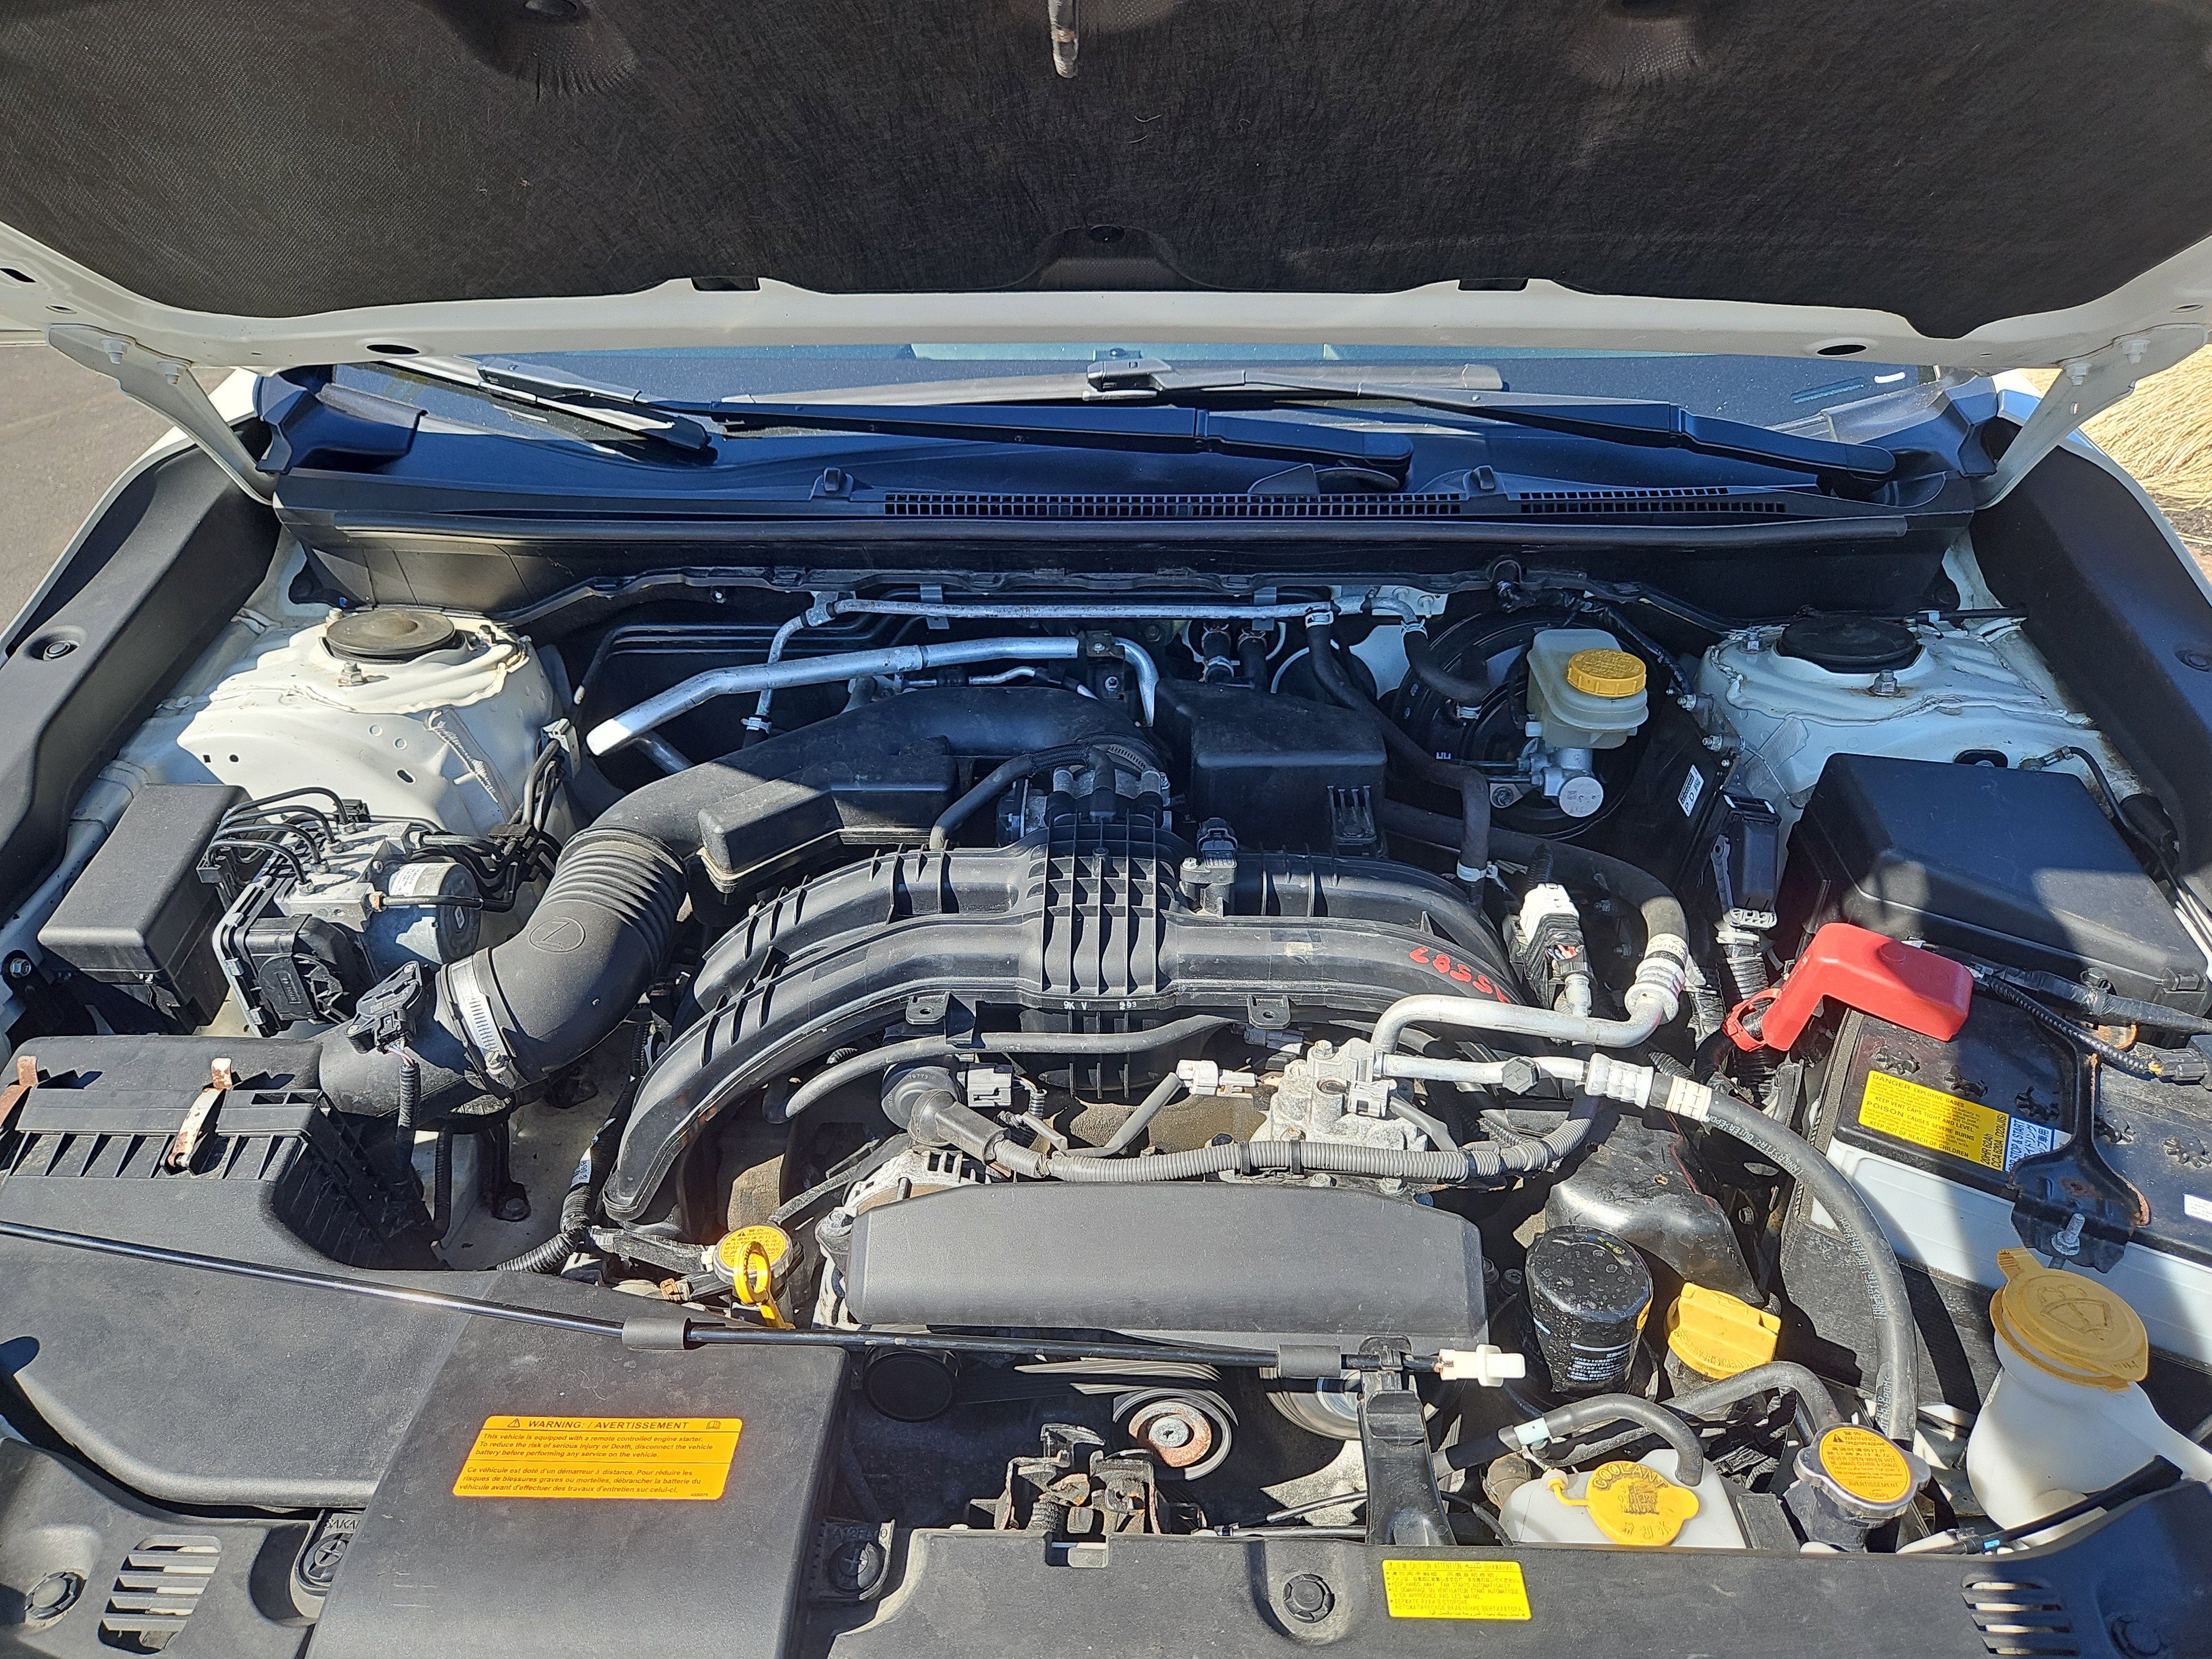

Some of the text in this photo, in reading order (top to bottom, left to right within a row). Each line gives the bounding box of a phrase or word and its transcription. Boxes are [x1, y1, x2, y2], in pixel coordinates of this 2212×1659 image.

[1872, 1073, 1965, 1108] DANGER EXPLOSIVE GASES
[1866, 1101, 1976, 1141] POISON CAUSES SEVERE BURNS
[1874, 1096, 1975, 1132] KEEP VENT CAPS TIGHT AND LEVEL
[2012, 1119, 2025, 1139] START
[1869, 1120, 1885, 1129] KEEP
[1907, 1133, 1928, 1143] REACH
[1938, 1143, 1970, 1158] CHILDREN
[1980, 1133, 1993, 1166] 20HR 62Ah
[1991, 1114, 2008, 1168] CCA 620A D23(JIS)
[2009, 1143, 2022, 1160] STOP
[529, 1420, 585, 1429] WARNING:
[1592, 1462, 1669, 1491] COOLANT
[324, 1519, 361, 1529] SAKA
